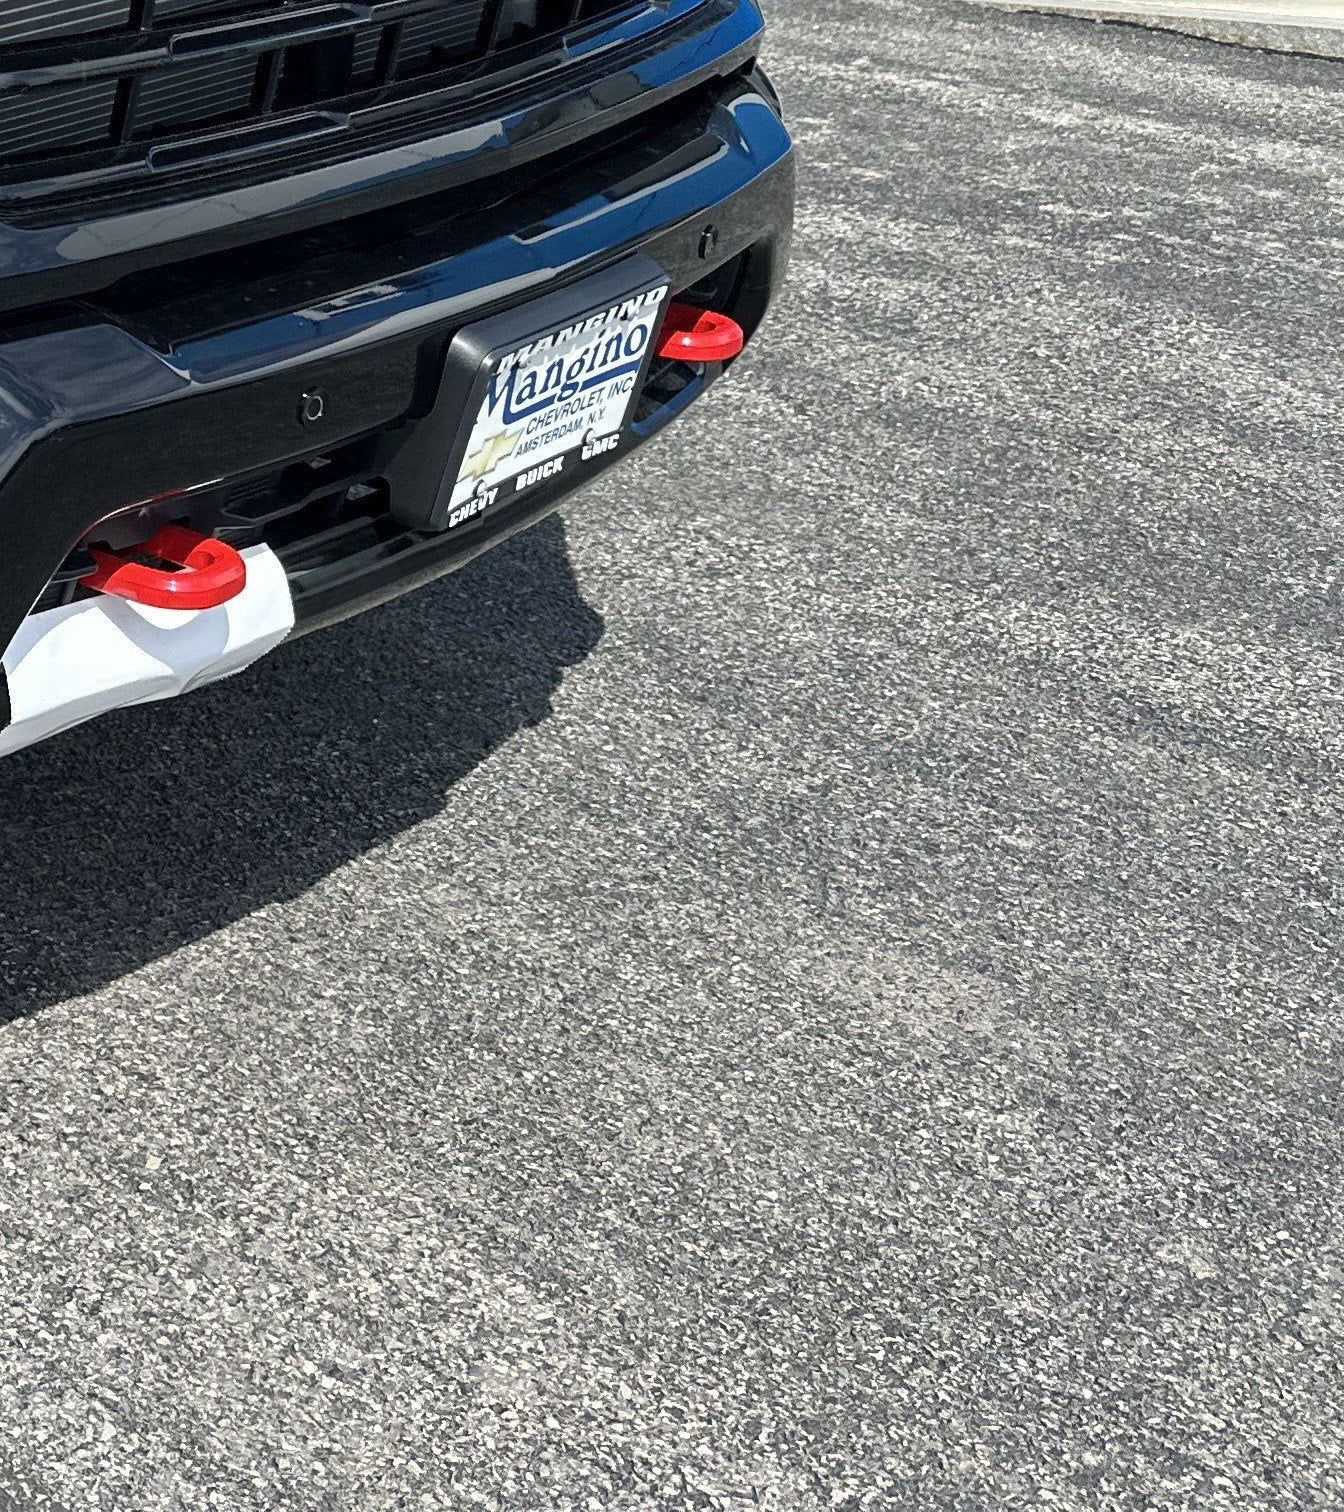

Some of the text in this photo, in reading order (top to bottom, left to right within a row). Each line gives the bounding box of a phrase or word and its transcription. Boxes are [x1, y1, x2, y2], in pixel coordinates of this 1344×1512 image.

[486, 323, 649, 425] Mangino
[496, 285, 669, 375] MANGINO
[449, 487, 499, 527] CHEVY
[515, 456, 565, 490] BUICK
